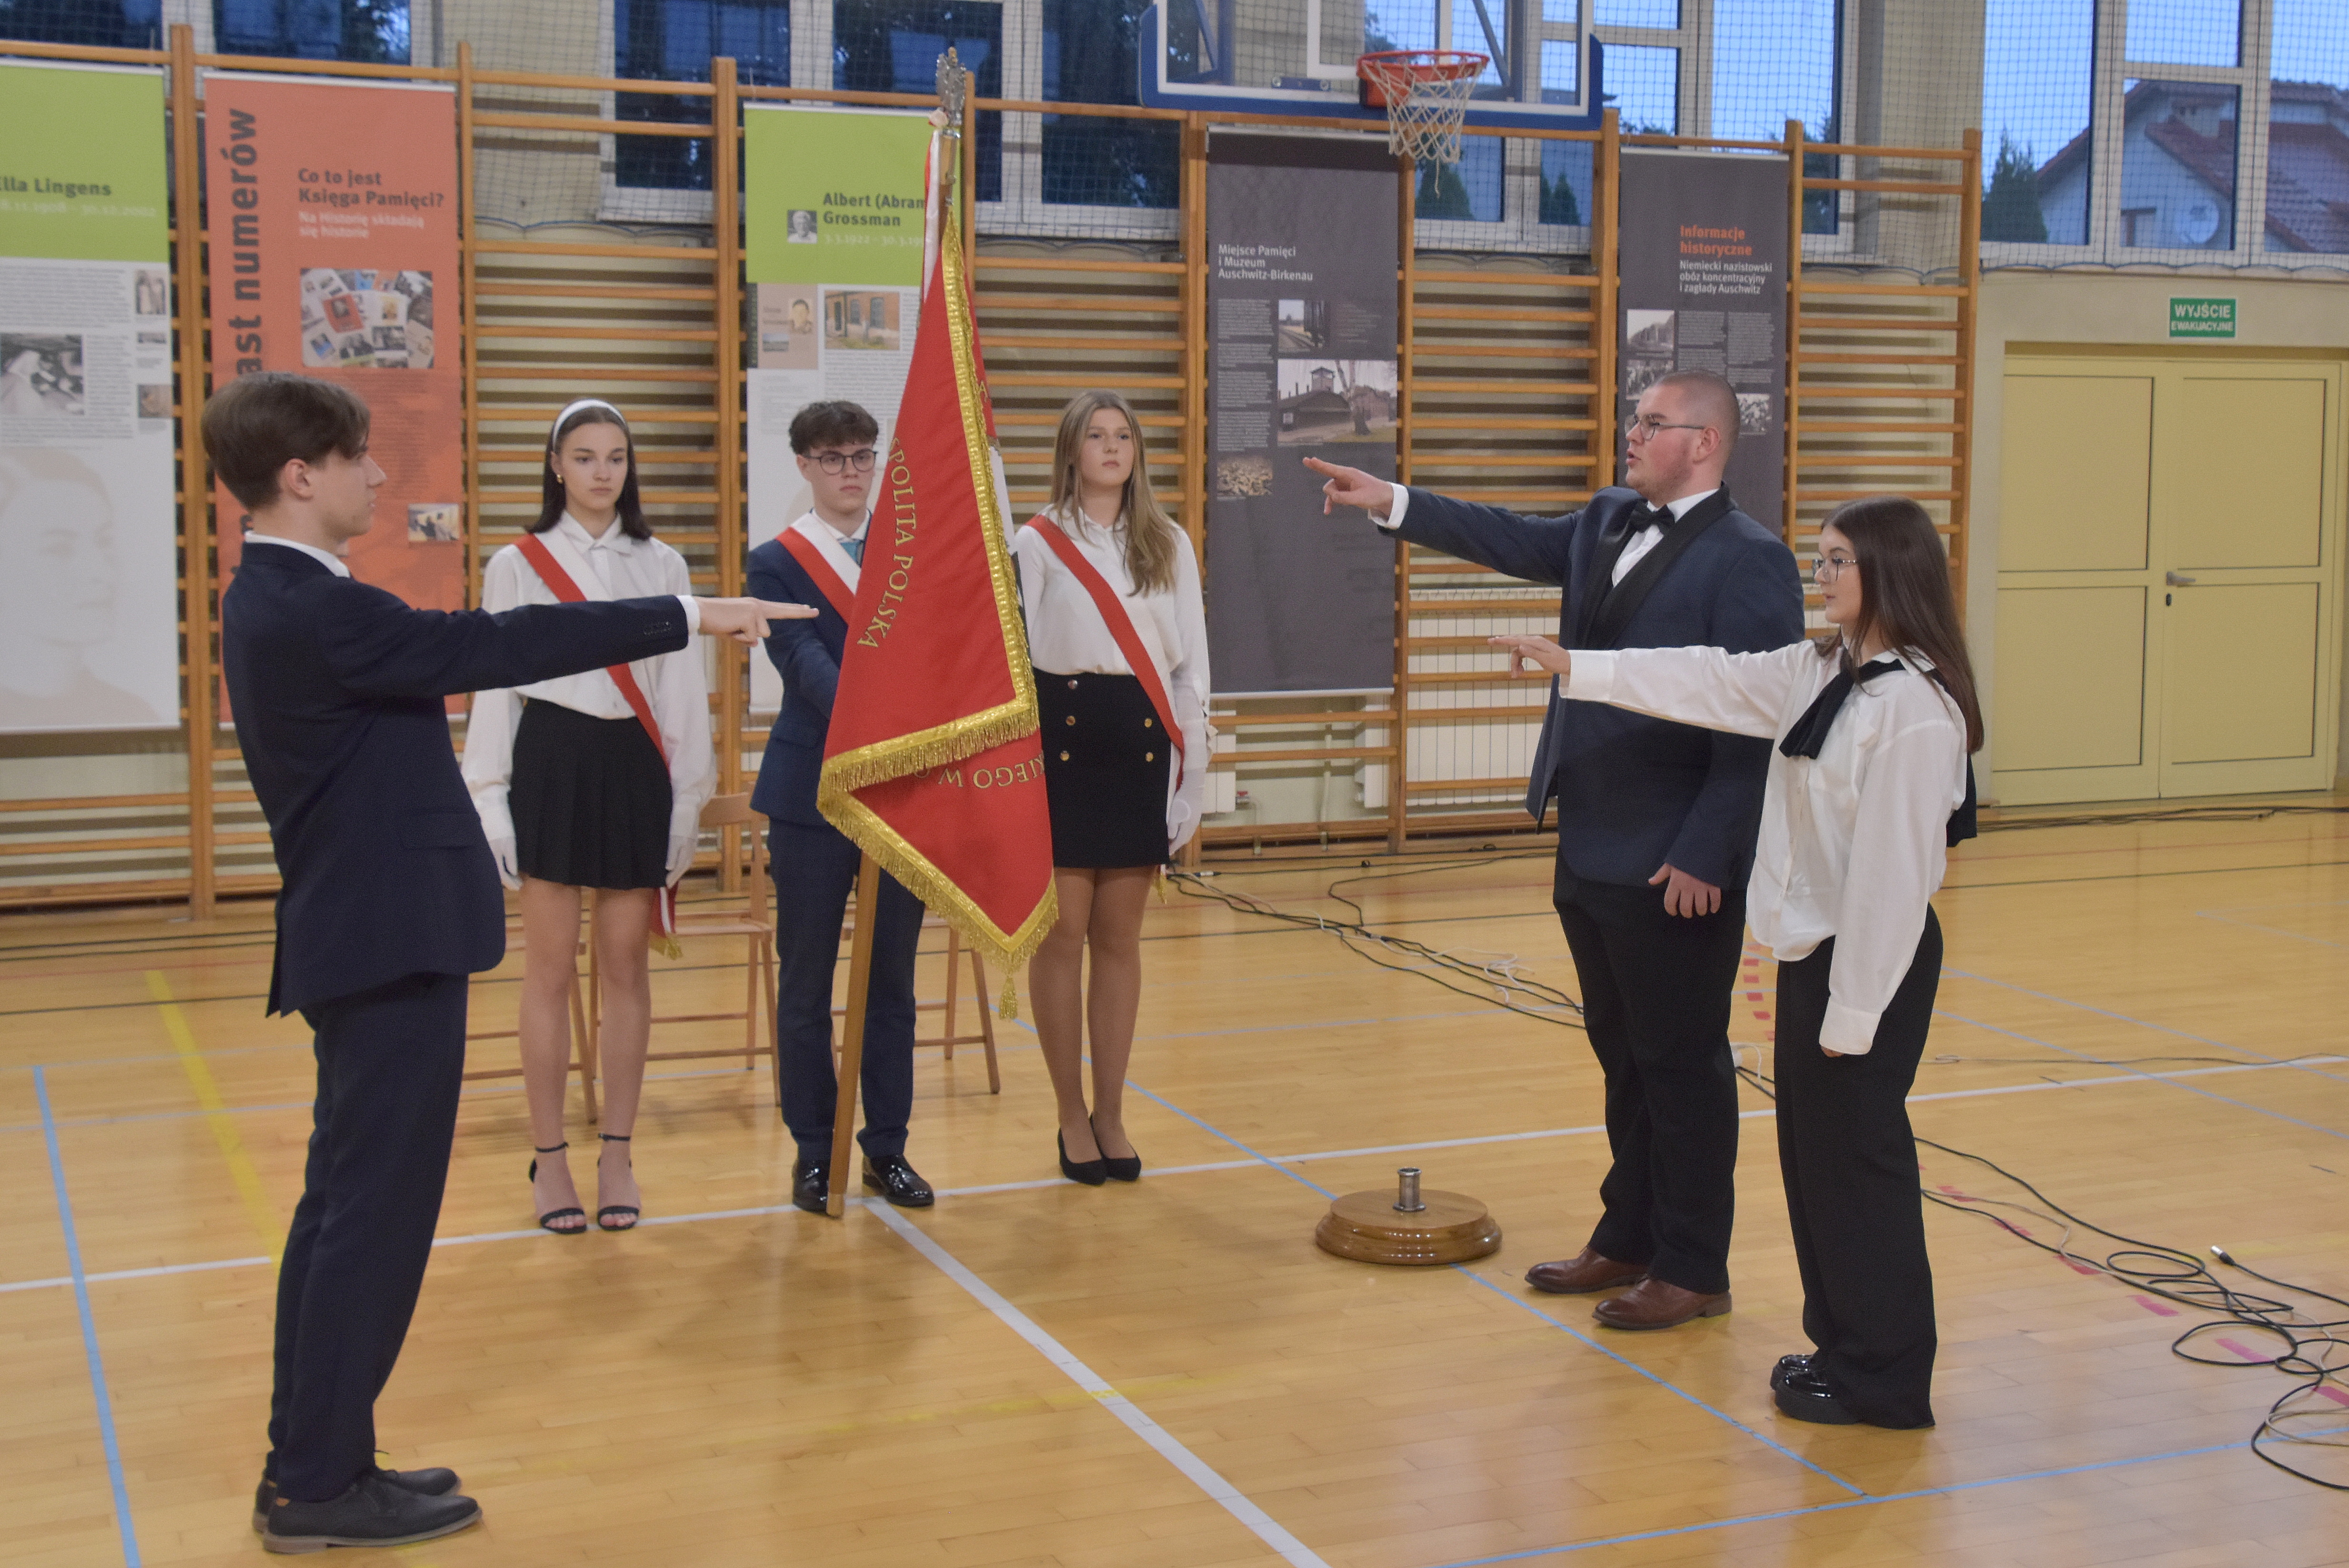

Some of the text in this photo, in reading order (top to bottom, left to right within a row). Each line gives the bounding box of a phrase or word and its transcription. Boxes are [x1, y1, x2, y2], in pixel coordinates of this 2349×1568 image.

[298, 168, 382, 188] Co to jest
[35, 178, 112, 198] Lingens
[220, 108, 261, 300] numerów
[298, 188, 445, 210] Księga Pamięci?
[823, 192, 871, 207] Albert
[823, 211, 901, 226] Grossman
[1680, 224, 1746, 242] Informacje
[1218, 244, 1296, 259] Miejsce Pamięci
[1680, 240, 1753, 258] historyczne
[1218, 256, 1266, 268] i Muzeum
[1679, 259, 1773, 273] Niemiecki nazistowski
[1218, 268, 1313, 281] Auschwitz-Birkenau
[1679, 271, 1766, 285] obóz koncentracyjny
[1679, 282, 1761, 295] i zagłady Auschwitz
[2174, 301, 2231, 318] WYJŚCIE
[2171, 320, 2234, 332] EWAKUACYJNE
[857, 554, 914, 648] POLSKA
